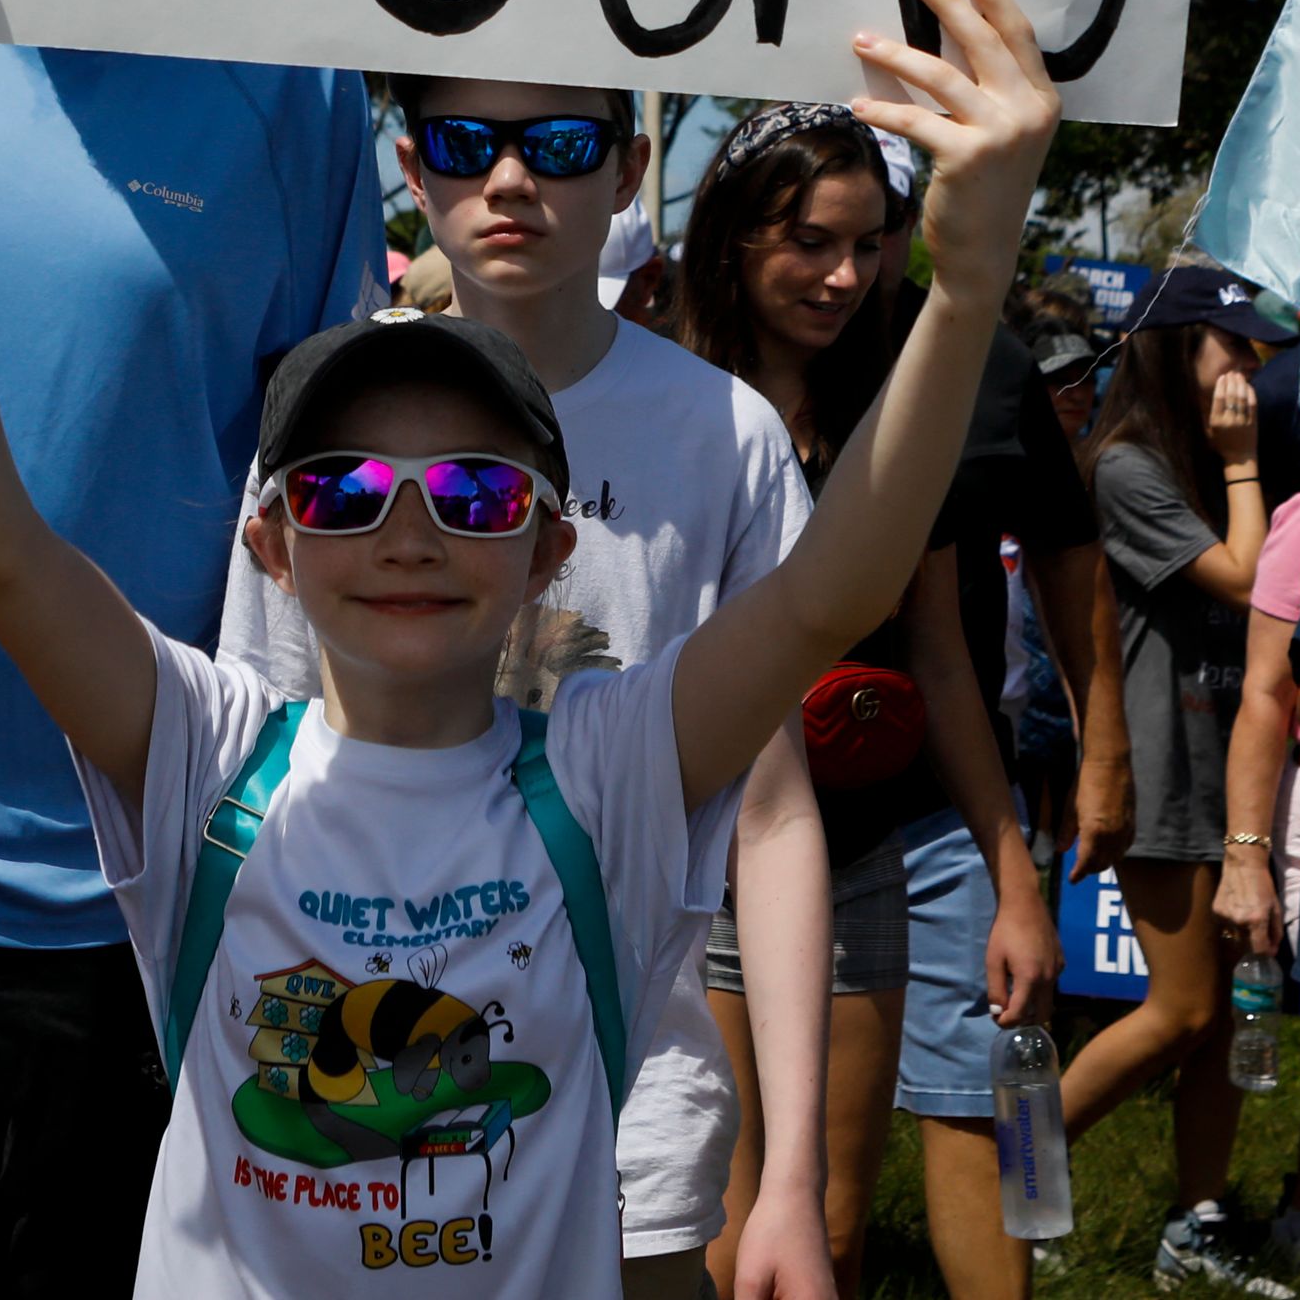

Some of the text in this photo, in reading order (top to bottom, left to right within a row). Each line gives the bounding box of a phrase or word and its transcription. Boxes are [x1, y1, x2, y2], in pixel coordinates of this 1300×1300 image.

[142, 182, 204, 208] Columbia
[298, 879, 531, 932] QUIET WATERS
[342, 918, 500, 948] ELEMENTARY
[284, 973, 337, 999] QWE
[1016, 1096, 1038, 1200] smartwater
[233, 1155, 399, 1212] IS THE PLACE TO
[359, 1213, 493, 1270] BEE!
